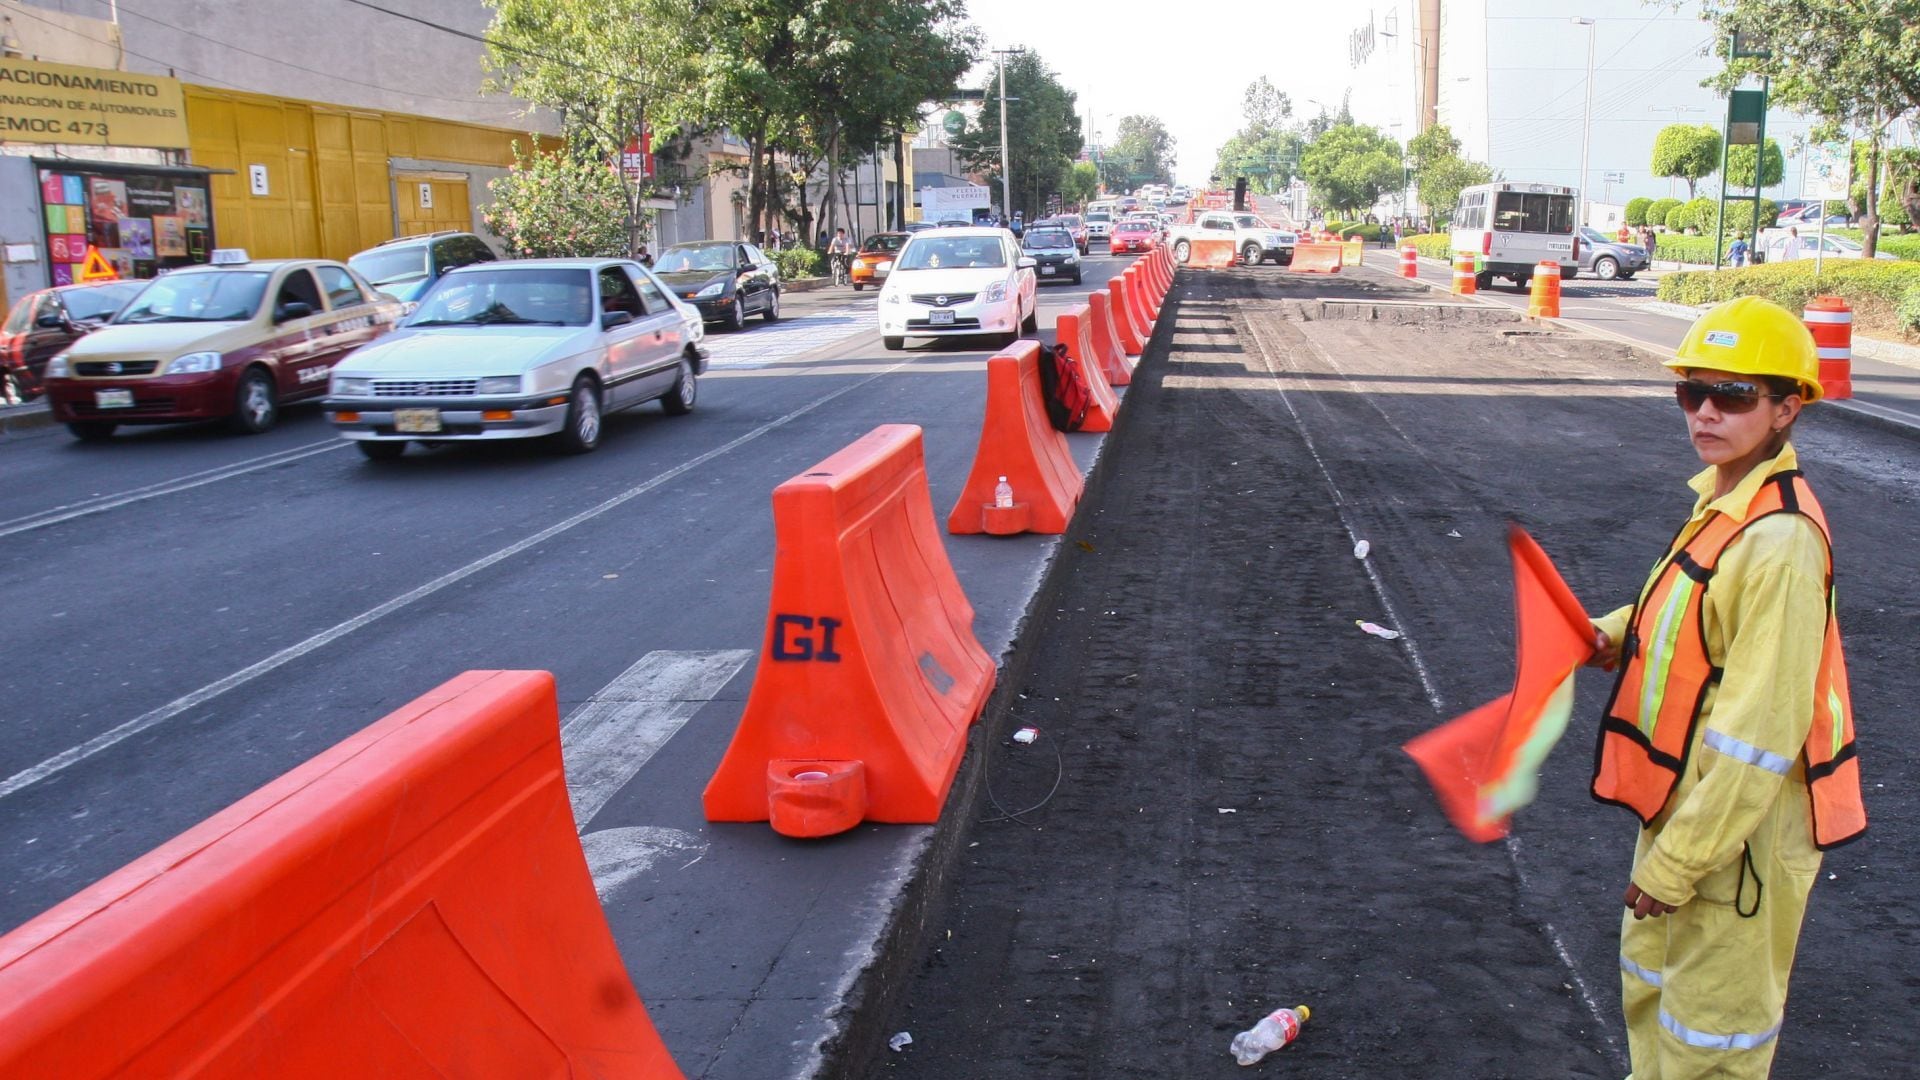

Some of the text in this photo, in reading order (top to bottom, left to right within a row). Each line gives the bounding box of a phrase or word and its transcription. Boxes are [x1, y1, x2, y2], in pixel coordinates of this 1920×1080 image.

[0, 67, 158, 97] ACIONAMIENTO
[67, 100, 86, 111] DE
[89, 102, 177, 118] AUTOMOVILES
[68, 121, 109, 136] 473
[773, 614, 843, 663] GI
